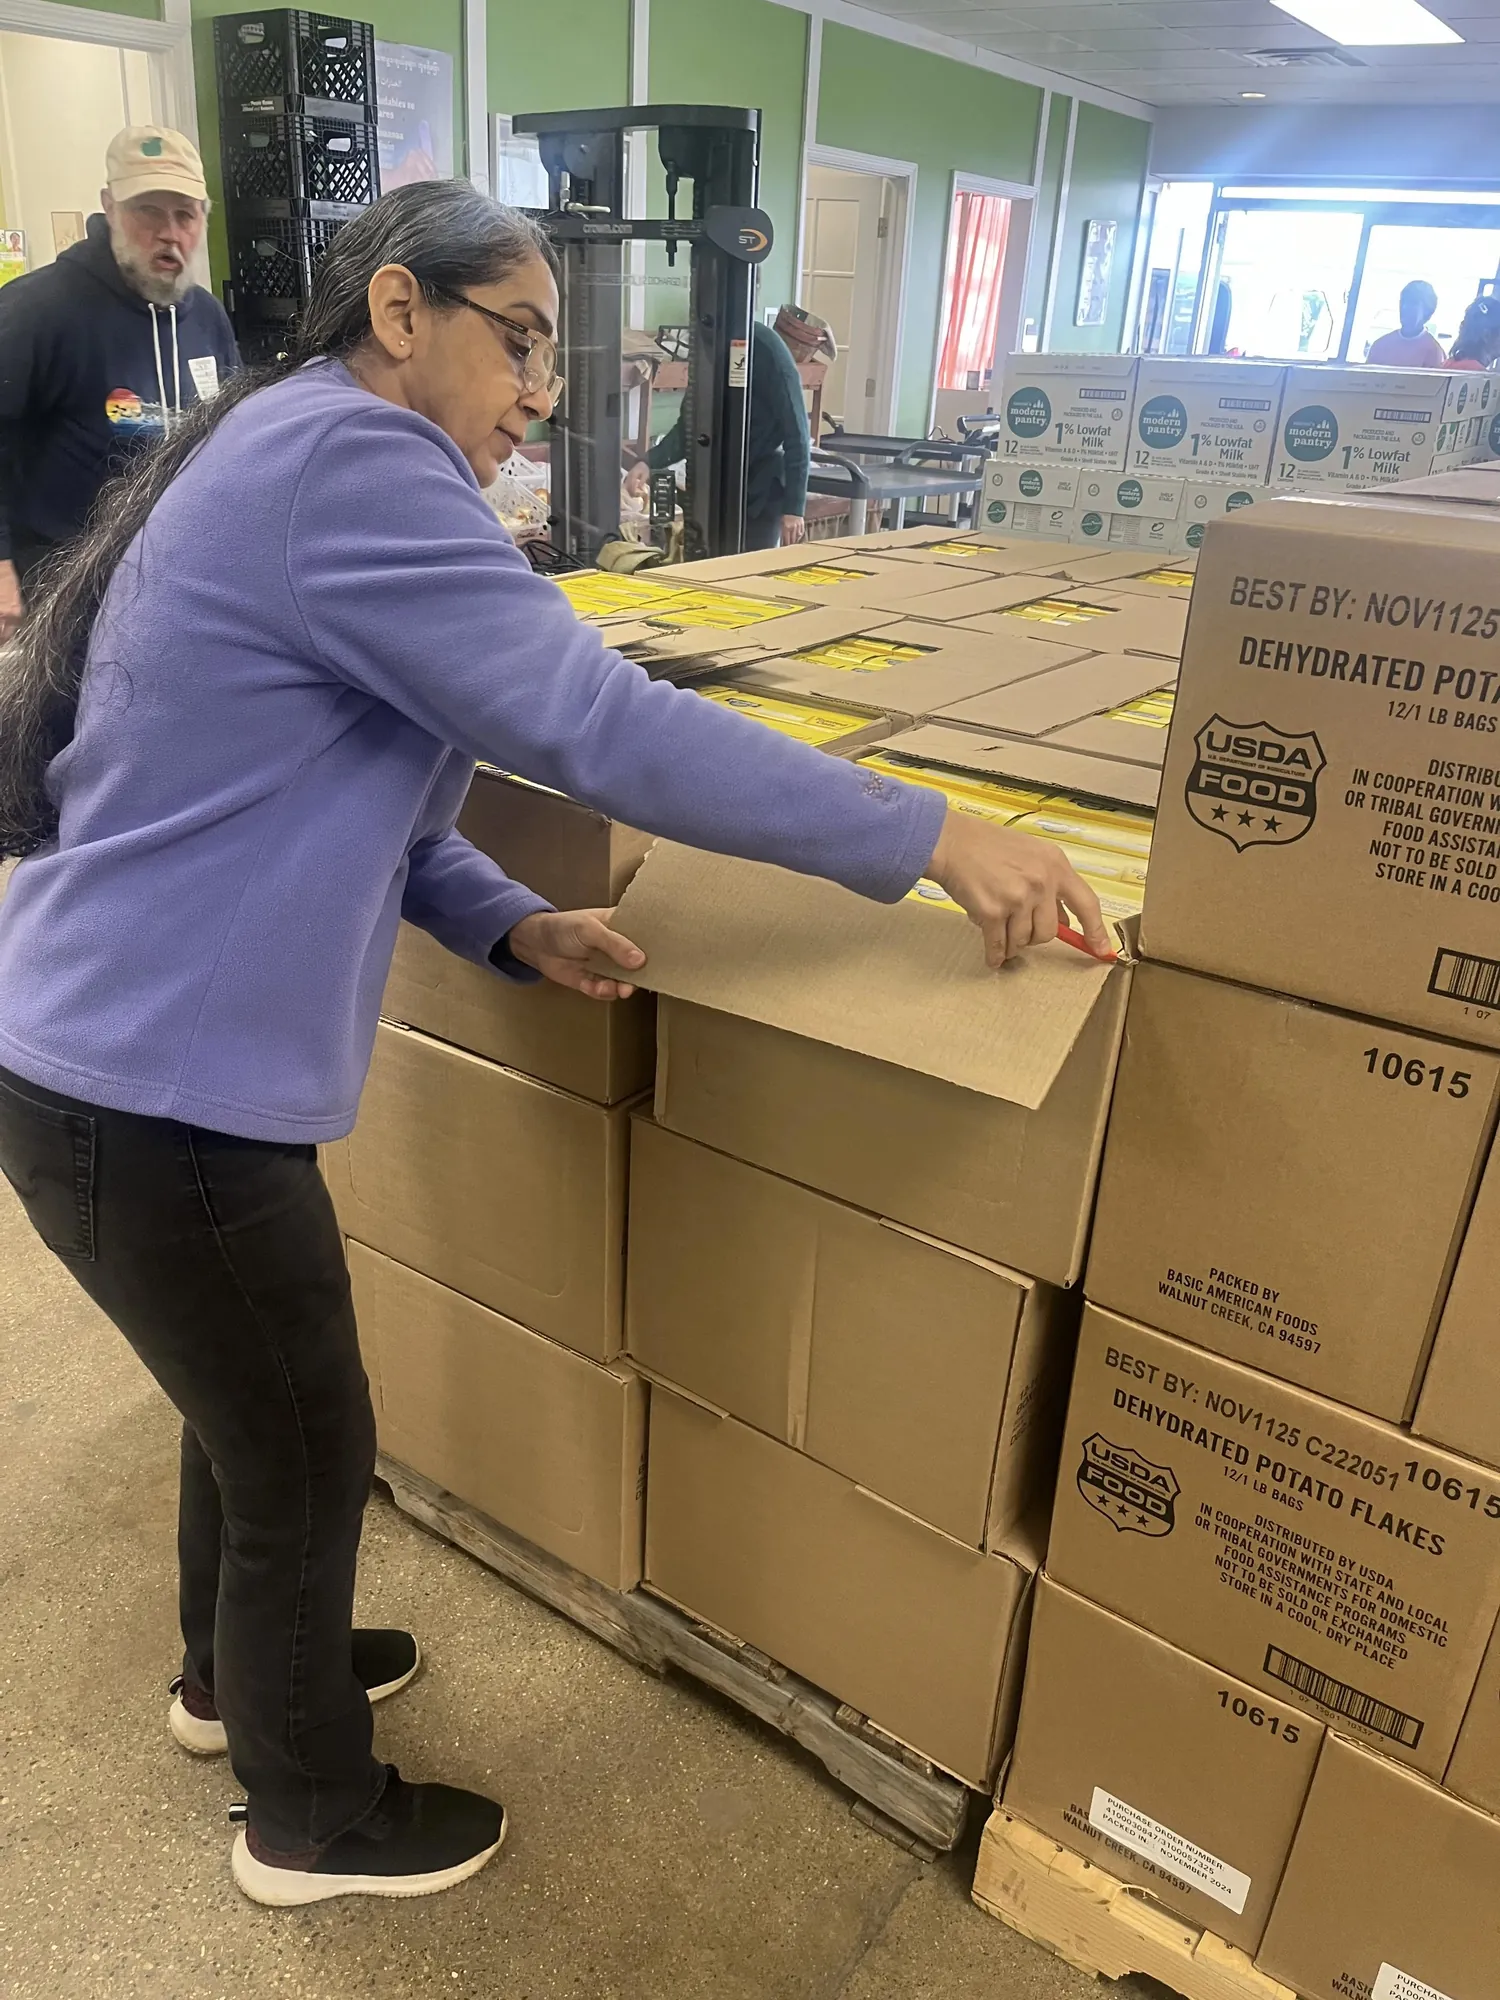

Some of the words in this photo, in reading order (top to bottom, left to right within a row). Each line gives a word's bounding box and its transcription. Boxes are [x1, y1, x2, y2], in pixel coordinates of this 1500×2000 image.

[738, 235, 756, 244] ST
[1011, 406, 1046, 416] modern
[1015, 416, 1047, 427] pantry
[1077, 424, 1111, 436] Lowfat
[1143, 416, 1181, 426] modern
[1005, 440, 1019, 454] 12
[1082, 436, 1104, 448] Milk
[1147, 425, 1182, 437] pantry
[1214, 435, 1253, 449] Lowfat
[1289, 427, 1332, 438] modern
[1293, 437, 1332, 449] pantry
[1135, 450, 1150, 466] 12
[1220, 448, 1244, 461] Milk
[1280, 463, 1296, 479] 12
[1368, 448, 1411, 462] Lowfat
[1373, 462, 1401, 475] Milk
[1327, 471, 1349, 479] Vitamin
[1230, 576, 1306, 612] BEST
[1310, 586, 1357, 620] BY:
[1364, 592, 1500, 639] NOV1125
[1239, 636, 1425, 692] DEHYDRATED
[1388, 701, 1421, 721] 12/1
[1428, 707, 1448, 725] LB
[1453, 711, 1498, 733] BAGS
[1206, 731, 1312, 770] USDA
[1199, 768, 1306, 808] FOOD
[1345, 790, 1366, 808] OR
[1371, 794, 1424, 820] TRIBAL
[1352, 768, 1370, 786] IN
[1373, 772, 1485, 808] COOPERATION
[1383, 820, 1424, 843] FOOD
[1427, 830, 1500, 859] ASSISTA
[1369, 840, 1402, 860] NOT
[1406, 847, 1425, 865] TO
[1429, 852, 1451, 871] BE
[1454, 857, 1497, 880] SOLD
[1375, 862, 1427, 887] STORE
[1429, 874, 1448, 892] IN
[1450, 879, 1462, 895] A
[1463, 1006, 1469, 1015] 1
[1476, 1009, 1491, 1020] 07
[1363, 1047, 1472, 1099] 10615
[1167, 1268, 1204, 1292] BASIC
[1206, 1284, 1272, 1319] AMERICAN
[1275, 1310, 1319, 1336] FOODS
[1209, 1267, 1259, 1296] PACKED
[1262, 1287, 1280, 1304] BY
[1158, 1281, 1208, 1311] WALNUT
[1210, 1303, 1253, 1332] CREEK,
[1258, 1321, 1274, 1338] CA
[1279, 1329, 1321, 1354] 94597
[1105, 1346, 1160, 1384] BEST
[1163, 1372, 1199, 1404] BY:
[1205, 1390, 1301, 1447] NOV1125
[1305, 1435, 1400, 1492] C22051
[1091, 1442, 1170, 1493] USDA
[1113, 1388, 1250, 1466] DEHYDRATED
[1255, 1453, 1344, 1510] POTATO
[1350, 1497, 1446, 1556] FLAKES
[1087, 1466, 1167, 1516] FOOD
[1224, 1466, 1248, 1486] 12/1
[1253, 1479, 1267, 1495] LB
[1271, 1488, 1304, 1512] BAGS
[1404, 1461, 1500, 1519] 10615
[1200, 1502, 1213, 1517] IN
[1215, 1510, 1297, 1559] COOPERATION
[1300, 1552, 1332, 1576] WITH
[1335, 1570, 1373, 1597] STATE
[1376, 1590, 1405, 1611] AND
[1407, 1604, 1449, 1634] LOCAL
[1255, 1514, 1335, 1562] DISTRIBUTED
[1338, 1555, 1357, 1572] BY
[1359, 1565, 1393, 1590] USDA
[1194, 1515, 1211, 1531] OR
[1214, 1524, 1253, 1553] TRIBAL
[1257, 1547, 1348, 1600] GOVERNMENTS
[1352, 1594, 1377, 1614] FOR
[1380, 1607, 1448, 1648] DOMESTIC
[1224, 1545, 1254, 1568] FOOD
[1257, 1563, 1331, 1608] ASSISTANCE
[1335, 1602, 1406, 1644] PROGRAMS
[1215, 1554, 1238, 1574] NOT
[1241, 1567, 1255, 1583] TO
[1259, 1577, 1273, 1592] BE
[1277, 1586, 1308, 1610] SOLD
[1312, 1604, 1328, 1622] OR
[1331, 1616, 1408, 1660] EXCHANGED
[1220, 1571, 1257, 1599] STORE
[1260, 1592, 1273, 1607] IN
[1276, 1600, 1285, 1613] A
[1287, 1606, 1323, 1634] COOL,
[1326, 1626, 1352, 1648] DRY
[1354, 1641, 1396, 1670] PLACE
[1217, 1690, 1300, 1744] 10615
[1070, 1803, 1090, 1821] BAS
[1063, 1810, 1103, 1841] WALNUT
[1142, 1860, 1156, 1876] CA
[1102, 1813, 1136, 1837] PACKED
[1160, 1847, 1208, 1880] NOVEMBER
[1210, 1877, 1232, 1895] 2024
[1107, 1797, 1153, 1828] PURCHASE
[1154, 1825, 1184, 1847] ORDER
[1186, 1844, 1225, 1872] NUMBER:
